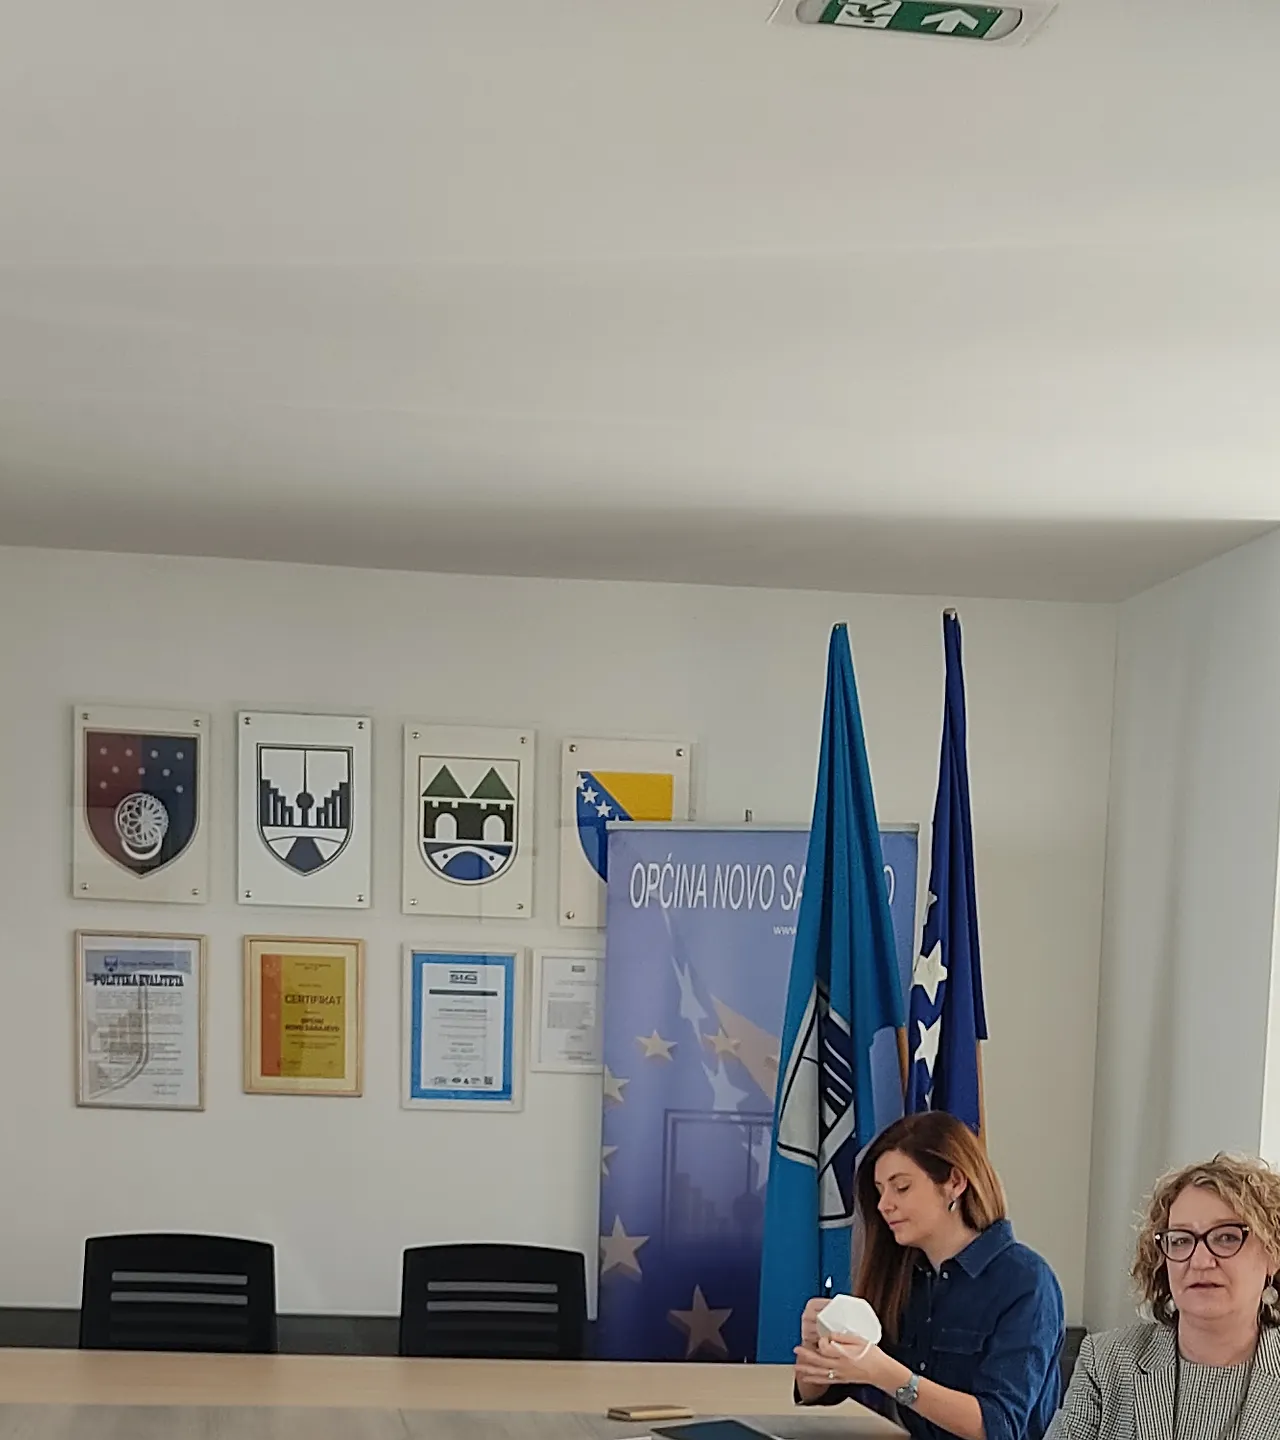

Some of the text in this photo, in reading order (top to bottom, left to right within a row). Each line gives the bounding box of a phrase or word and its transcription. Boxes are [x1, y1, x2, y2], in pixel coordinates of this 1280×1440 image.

[629, 852, 707, 909] OPĆINA
[713, 864, 776, 910] NOVO
[93, 973, 184, 987] POLITIKA KVALITETA
[284, 994, 342, 1005] CERTIFIKAT
